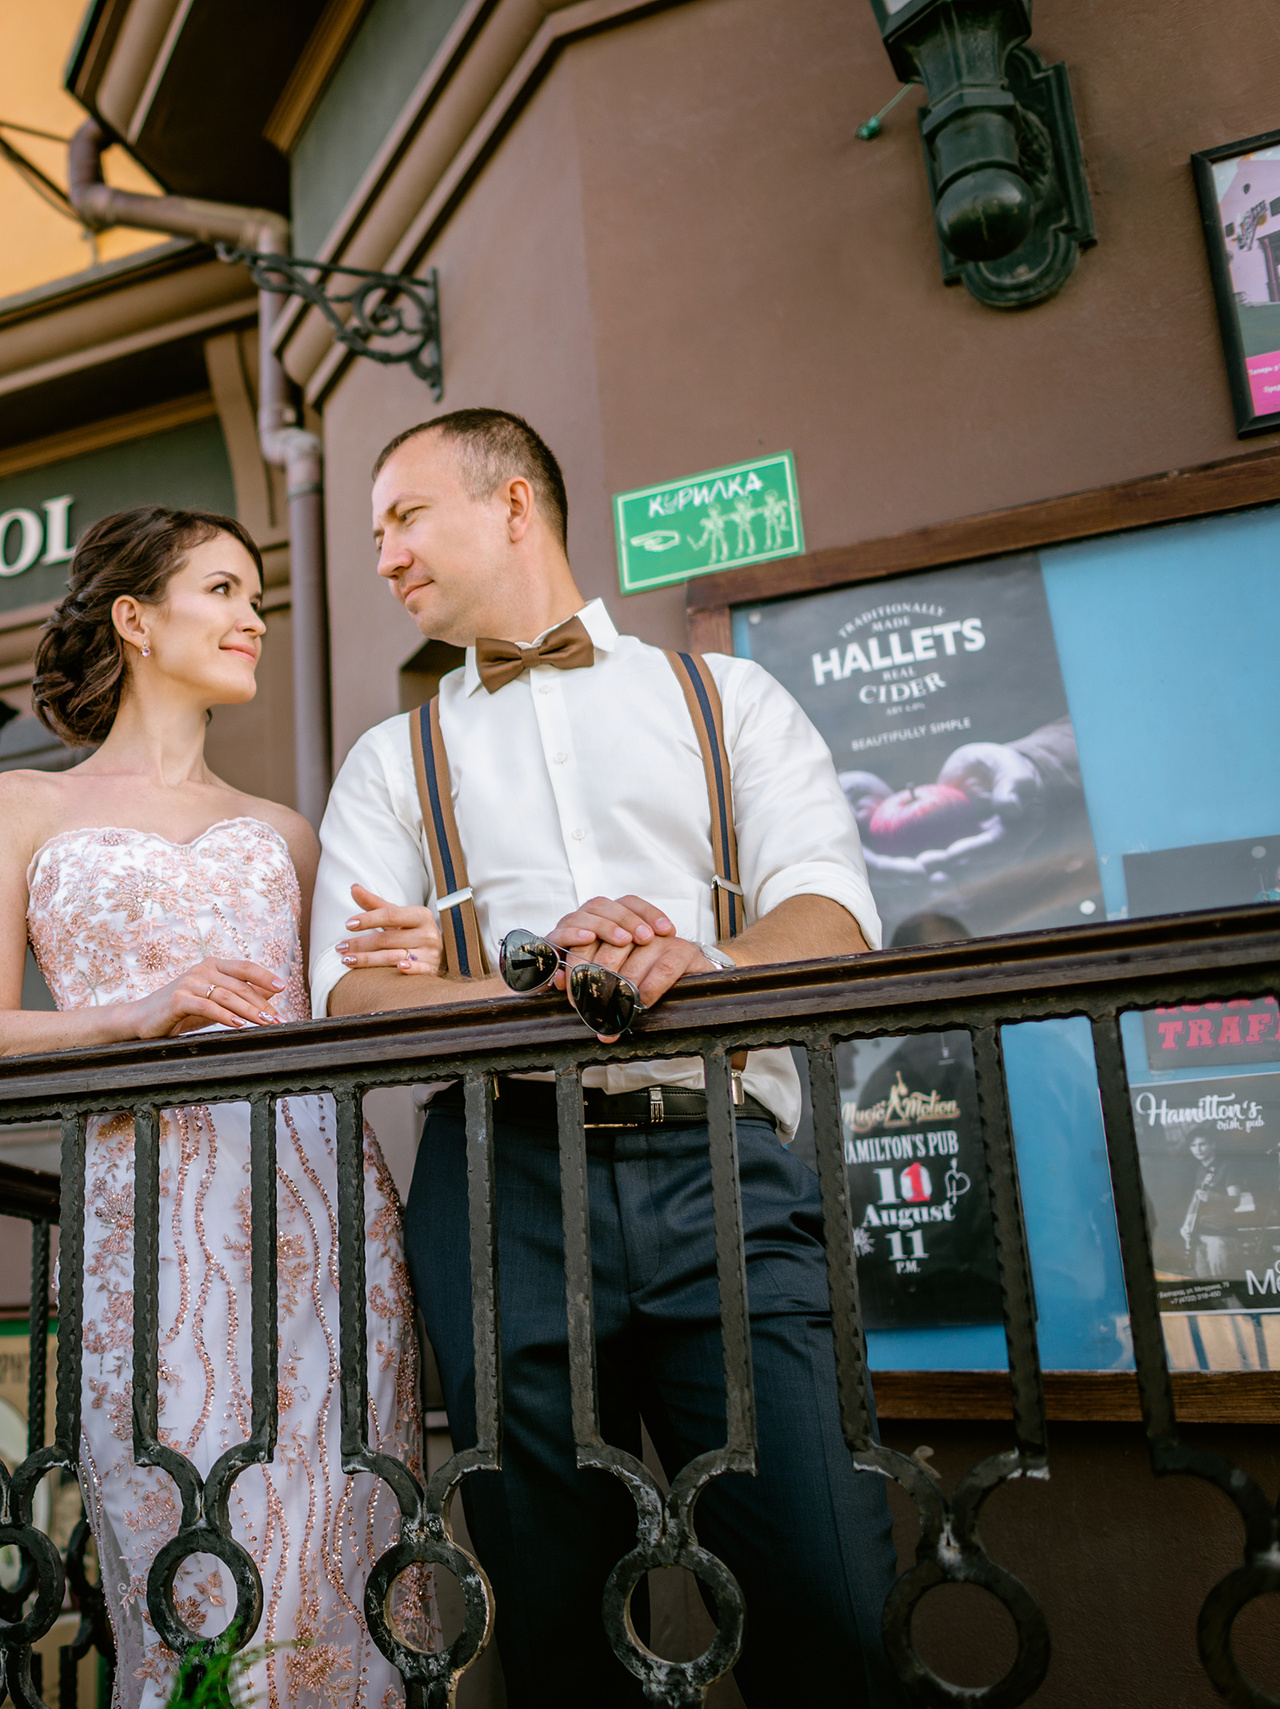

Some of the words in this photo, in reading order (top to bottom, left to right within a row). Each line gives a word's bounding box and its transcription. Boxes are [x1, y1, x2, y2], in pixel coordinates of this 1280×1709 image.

[648, 471, 763, 518] КУРИЛКА
[837, 602, 946, 638] TRADITIONALLY
[871, 615, 911, 633] MADE
[812, 618, 986, 686] HALLETS
[859, 672, 947, 704] CIDER
[882, 666, 916, 682] REAL
[851, 724, 926, 751] BEAUTIFULLY
[930, 716, 971, 735] SIMPLE
[842, 1101, 886, 1132] Music
[902, 1090, 960, 1124] Motion
[1246, 1115, 1265, 1133] pub
[927, 1130, 959, 1156] PUB
[862, 1200, 956, 1230] August
[885, 1229, 930, 1260] 11
[895, 1260, 921, 1274] P.M.
